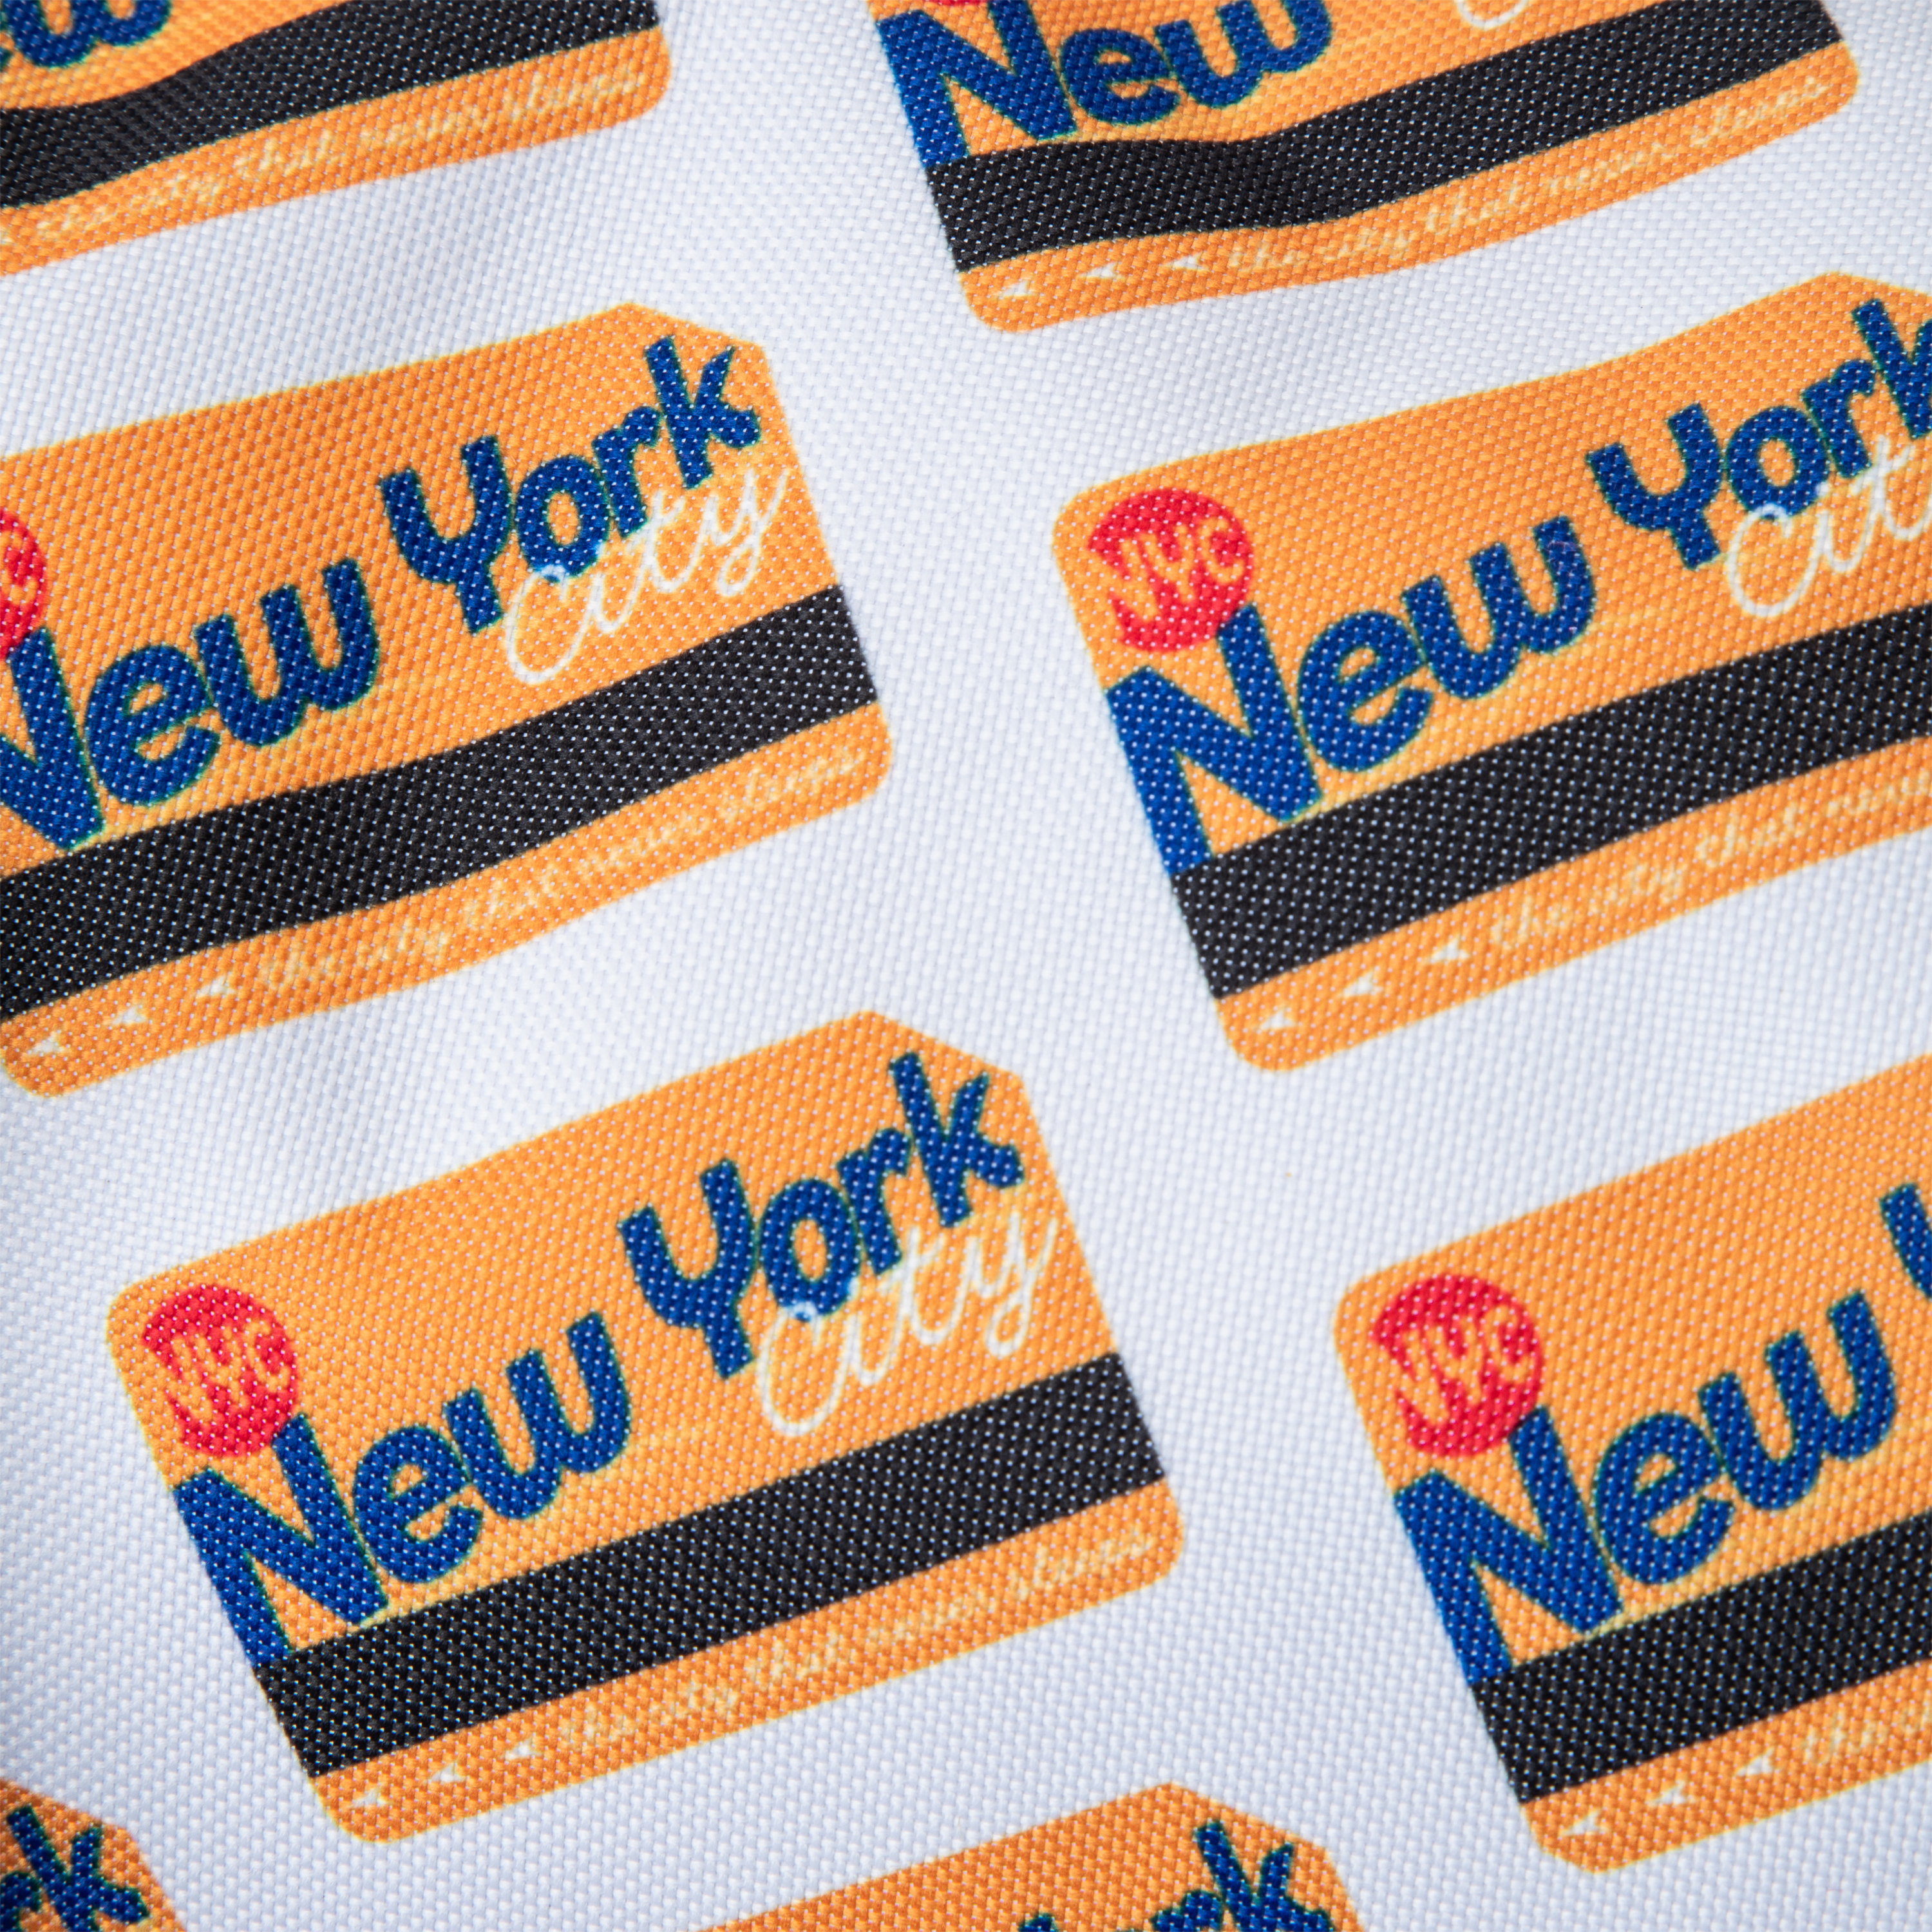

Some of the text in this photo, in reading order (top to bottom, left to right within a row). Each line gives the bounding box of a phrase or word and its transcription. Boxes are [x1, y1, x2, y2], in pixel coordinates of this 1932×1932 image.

[876, 0, 1331, 168] New
[377, 334, 761, 636] York
[504, 468, 795, 685] City
[1088, 515, 1247, 642] NYC
[1103, 298, 1932, 876] New York
[1725, 433, 1932, 618] Cit
[171, 1052, 1026, 1665] New York
[755, 1210, 1058, 1438] City
[1393, 1289, 1898, 1685] New
